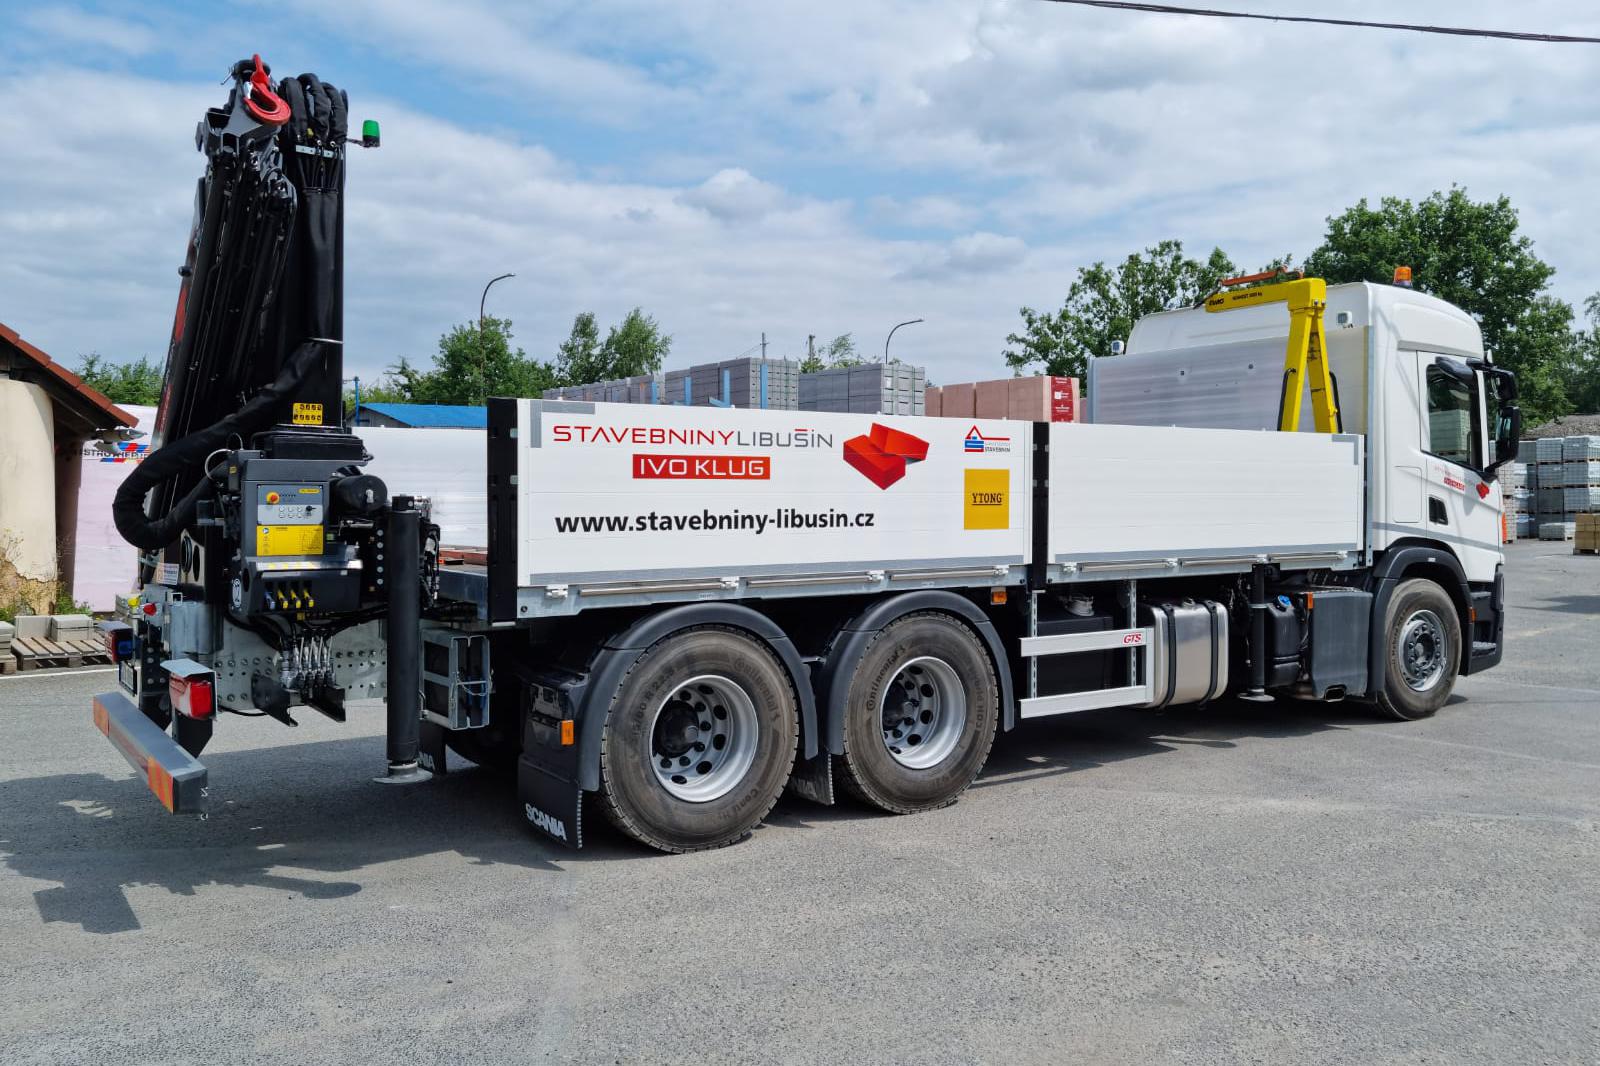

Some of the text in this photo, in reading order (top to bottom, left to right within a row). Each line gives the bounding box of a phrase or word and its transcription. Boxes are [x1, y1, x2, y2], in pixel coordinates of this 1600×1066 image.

[640, 458, 764, 476] IVO KLUG
[972, 493, 1003, 504] YTONG
[555, 508, 875, 534] www.stavebniny-libusin.cz
[1123, 633, 1142, 644] GTS
[525, 803, 567, 841] SCANIA
